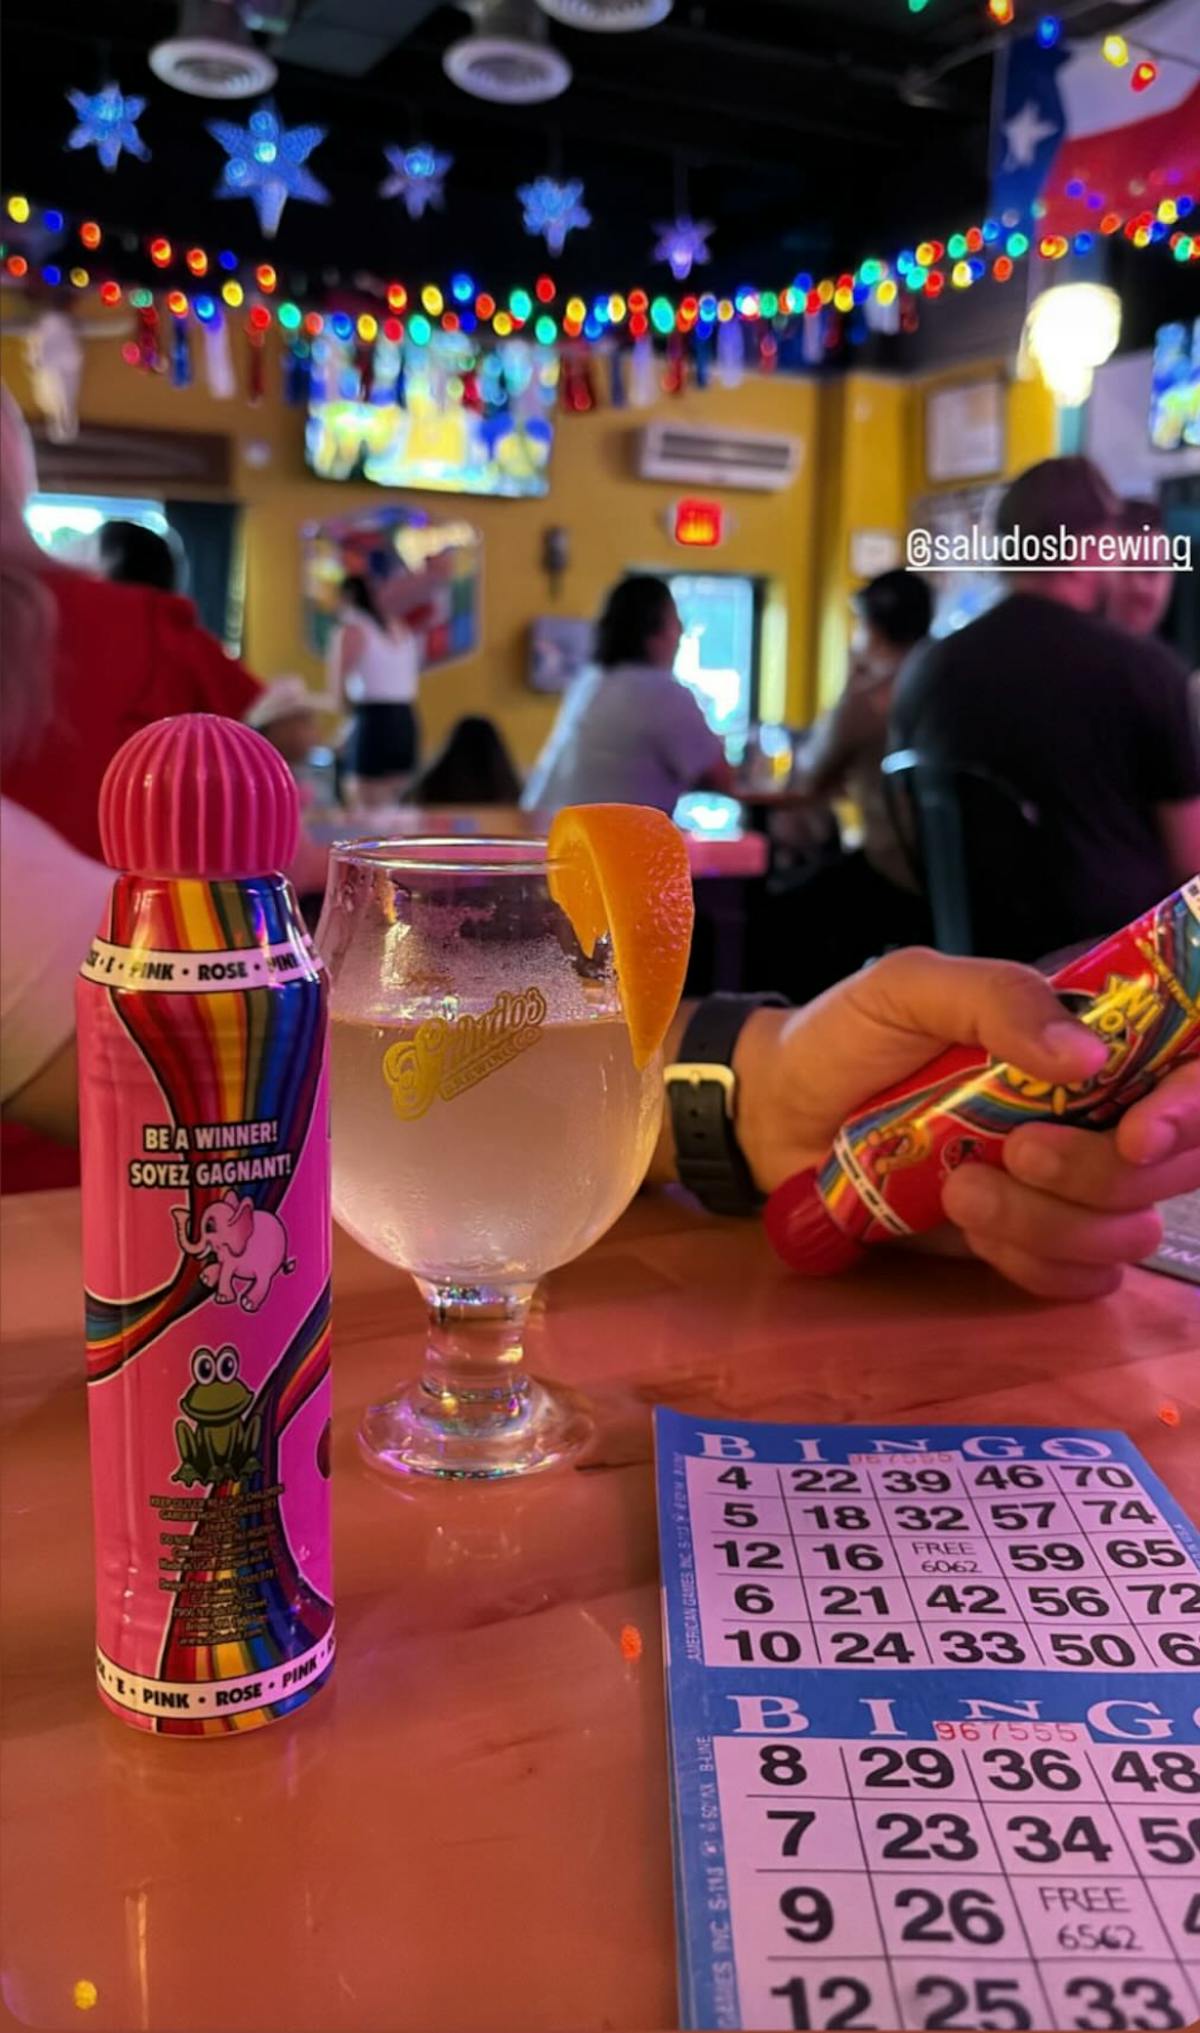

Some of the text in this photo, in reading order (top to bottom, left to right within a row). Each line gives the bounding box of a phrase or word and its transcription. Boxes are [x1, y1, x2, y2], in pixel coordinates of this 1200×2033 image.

[198, 962, 248, 981] ROSE
[144, 1121, 279, 1150] BE A WINNER!
[130, 1153, 292, 1186] SOYEZ GAGNANT!
[717, 1464, 1134, 1494] 4 22 39 46 70
[724, 1500, 1157, 1531] 5 18 32 57 74
[713, 1540, 784, 1570] 12
[812, 1543, 884, 1572] 16
[911, 1541, 977, 1556] FREE
[1008, 1542, 1085, 1572] 59
[1105, 1539, 1186, 1569] 65
[921, 1559, 983, 1574] 6062
[734, 1582, 1200, 1617] 6 21 42 56 72
[724, 1629, 802, 1663] 10
[830, 1631, 916, 1664] 24
[939, 1630, 1026, 1665] 33
[1049, 1633, 1136, 1668] 50
[143, 1688, 189, 1708] PINK
[216, 1683, 262, 1706] ROSE
[282, 1654, 317, 1689] PINK
[935, 1721, 1078, 1742] 967555
[759, 1744, 1200, 1794] 8 29 36 48
[766, 1810, 1200, 1865] 7 23 34 5
[779, 1886, 1131, 1946] 9 26 FREE
[1057, 1923, 1143, 1951] 6562
[771, 1975, 1186, 2032] 12 25 33
